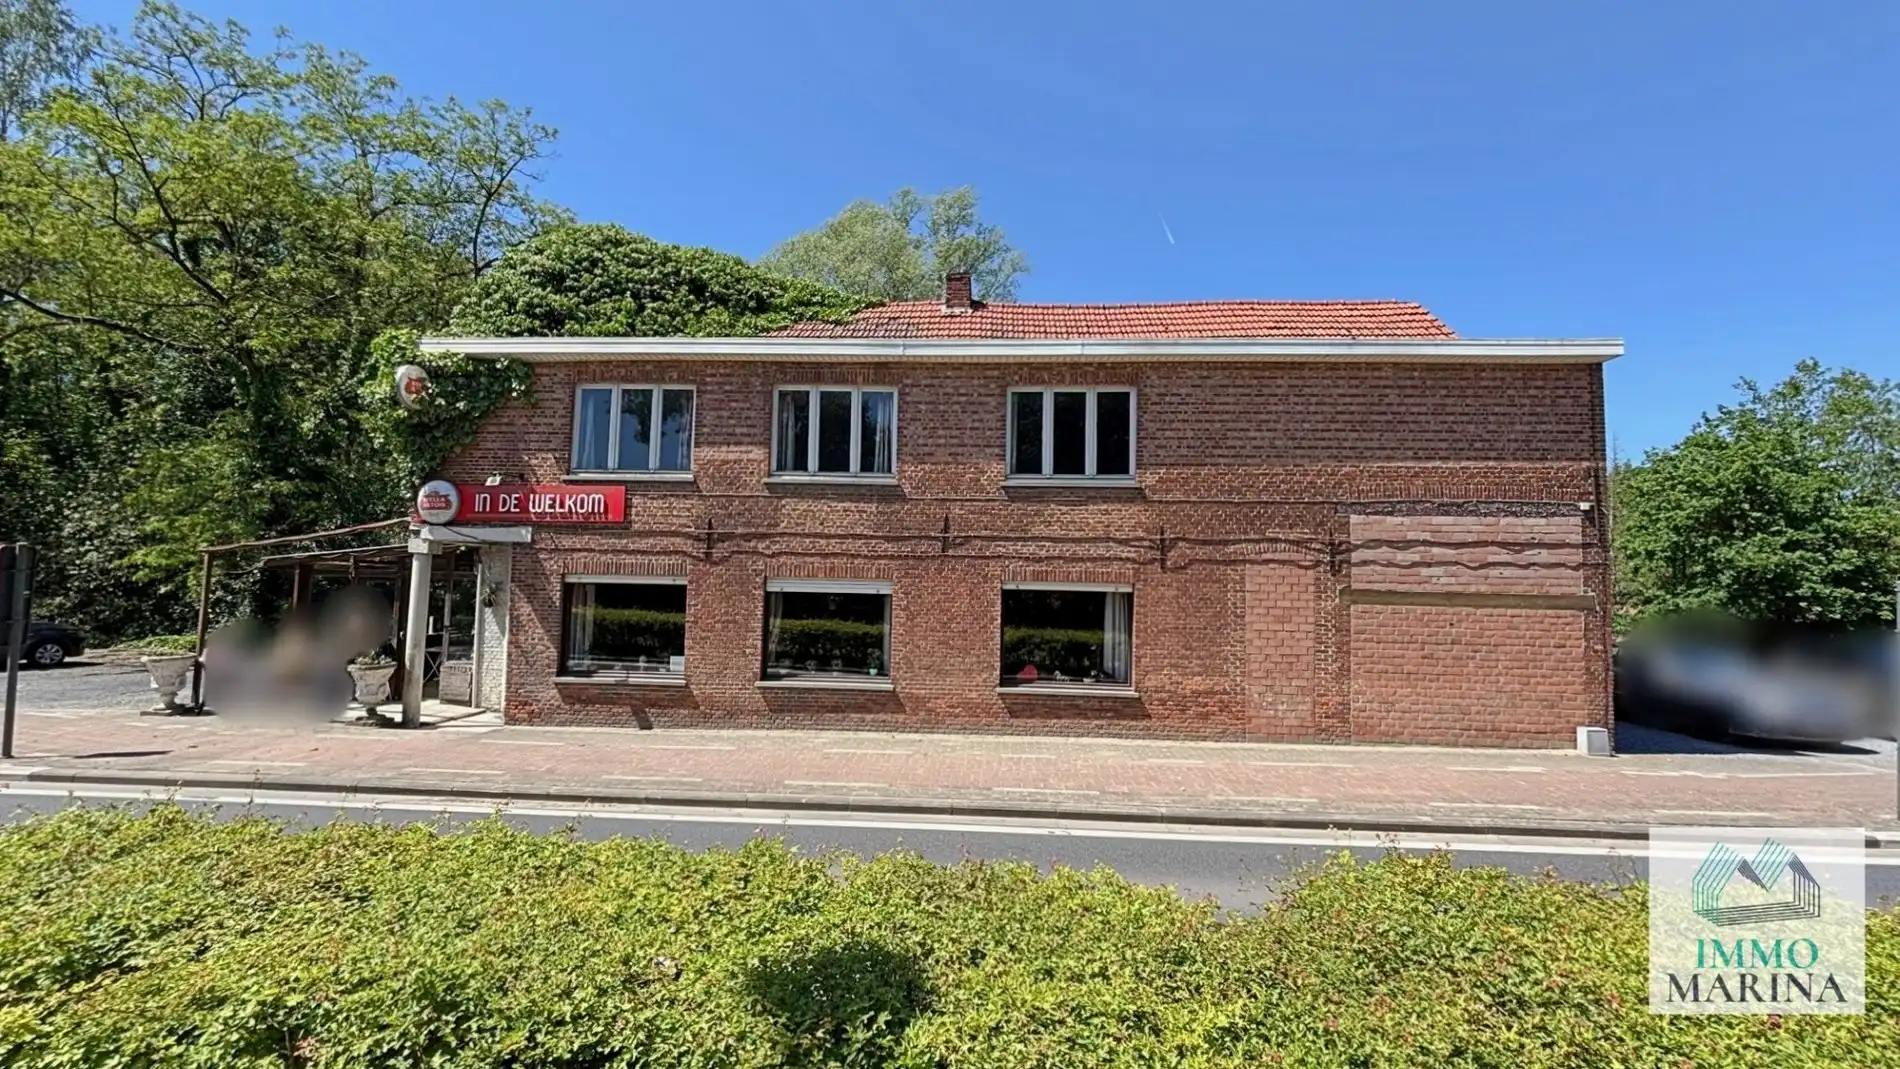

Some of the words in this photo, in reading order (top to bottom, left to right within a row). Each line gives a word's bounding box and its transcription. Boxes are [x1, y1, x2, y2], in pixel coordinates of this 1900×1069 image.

[475, 493, 490, 512] IN
[499, 493, 520, 512] DE
[529, 493, 604, 513] WELKOM
